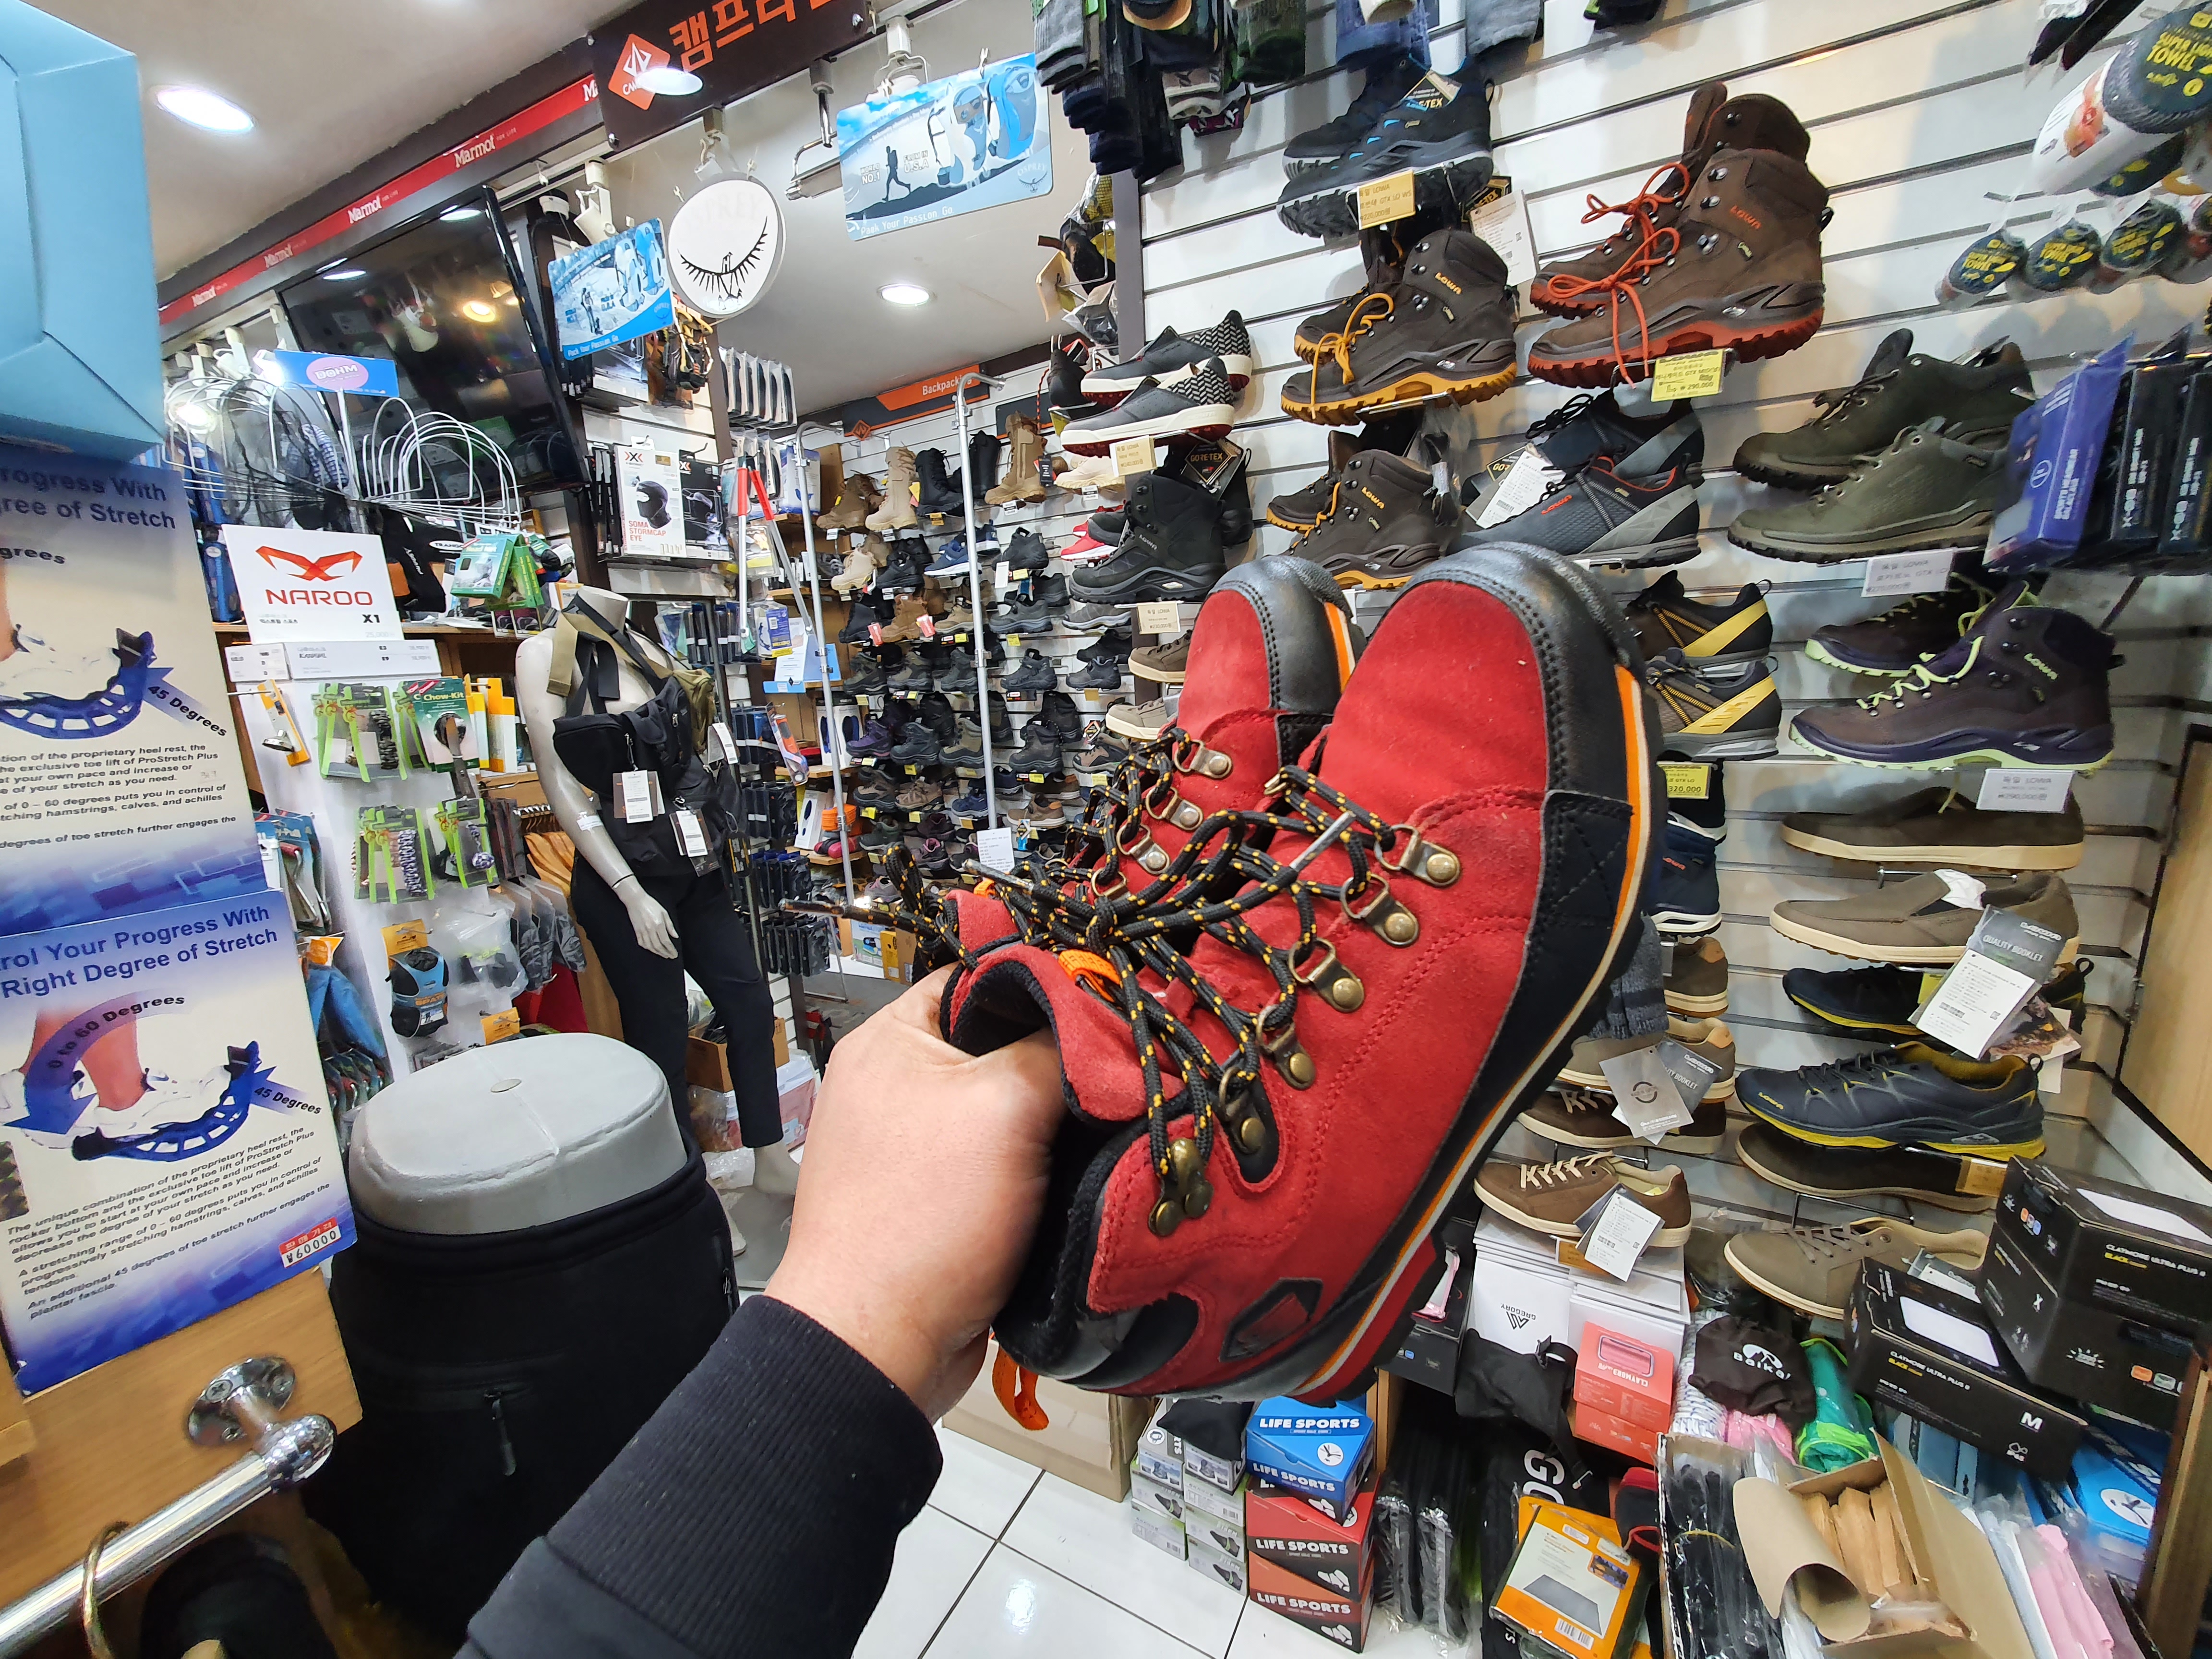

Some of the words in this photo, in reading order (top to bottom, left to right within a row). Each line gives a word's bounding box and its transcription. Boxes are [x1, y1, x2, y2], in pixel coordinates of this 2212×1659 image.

[2146, 45, 2197, 72] TOWEL
[454, 135, 496, 169] Marmot
[903, 152, 920, 163] FROM
[921, 150, 929, 159] IN
[860, 163, 880, 175] WORLD
[904, 160, 930, 173] U.S.A
[1016, 162, 1048, 177] OSPREY
[861, 173, 881, 185] NO.1
[1373, 184, 1390, 194] LOWA
[348, 195, 383, 224] Marmot
[1730, 205, 1761, 229] LOWA
[860, 221, 880, 236] Pack
[881, 217, 901, 231] Your
[264, 243, 293, 268] Marmot
[1435, 272, 1462, 294] LOWA
[110, 477, 167, 501] With
[1362, 487, 1385, 509] LOWA
[56, 500, 82, 519] of
[90, 503, 176, 529] Stretch
[628, 520, 649, 529] SOMA
[629, 528, 666, 537] STORMCAP
[1139, 534, 1157, 551] LOWA
[265, 589, 373, 605] NAROO
[362, 614, 380, 623] X1
[2024, 653, 2057, 680] LOWA
[423, 692, 465, 701] Chow-Kit
[148, 686, 169, 700] 45
[169, 697, 227, 737] Degrees
[20, 763, 81, 772] exclusive
[138, 754, 194, 764] ProStretch
[31, 753, 44, 761] of
[72, 748, 136, 759] proprietary
[139, 746, 161, 754] heel
[165, 745, 187, 753] rest,
[14, 775, 44, 784] your
[77, 771, 106, 780] pace
[109, 768, 131, 776] and
[134, 765, 179, 774] increase
[30, 784, 59, 793] your
[63, 780, 105, 790] stretch
[125, 778, 145, 786] you
[45, 799, 60, 807] 60
[63, 795, 111, 805] degrees
[114, 793, 139, 802] puts
[143, 791, 162, 800] you
[178, 784, 214, 795] control
[46, 805, 118, 817] hamstrings,
[121, 801, 159, 811] calves,
[163, 797, 182, 806] and
[185, 793, 223, 804] achilles
[0, 838, 51, 849] degrees
[94, 828, 134, 838] stretch
[137, 823, 173, 833] further
[176, 818, 219, 829] engages
[0, 948, 39, 971] rol
[46, 938, 108, 962] Your
[115, 917, 219, 950] Progress
[222, 906, 270, 928] With
[1983, 934, 2013, 951] QUALITY
[2011, 945, 2044, 962] BOOKLET
[1, 969, 78, 998] Right
[84, 952, 170, 983] Degree
[177, 944, 199, 962] of
[204, 928, 278, 957] Stretch
[74, 1020, 100, 1038] 60
[102, 996, 185, 1022] Degrees
[1674, 1072, 1699, 1090] BOOKLET
[254, 1086, 273, 1099] 45
[272, 1092, 323, 1115] Degrees
[149, 1176, 198, 1198] exclusive
[247, 1139, 294, 1162] ProStretch
[296, 1130, 314, 1142] Plus
[243, 1153, 282, 1173] increase
[35, 1208, 79, 1227] unique
[83, 1182, 155, 1212] combination
[191, 1150, 245, 1176] proprietary
[248, 1140, 267, 1153] heel
[290, 1127, 304, 1136] the
[287, 1166, 319, 1185] achilles
[184, 1197, 225, 1218] degrees
[281, 1162, 311, 1179] control
[184, 1186, 219, 1204] stretch
[247, 1206, 278, 1224] further
[279, 1189, 315, 1211] engages
[2150, 1256, 2177, 1269] ULTRA
[2176, 1264, 2199, 1275] PLUS
[1500, 1303, 1536, 1321] GREGORY
[1732, 1351, 1792, 1381] Baikal
[1890, 1350, 1926, 1371] CLAYMORE
[1926, 1367, 1947, 1381] ULTRA
[1947, 1376, 1965, 1389] PLUS
[1259, 1418, 1292, 1429] LIFE
[1295, 1419, 1360, 1429] SPORTS
[2020, 1411, 2044, 1431] M
[1253, 1463, 1278, 1478] LIFE
[1281, 1471, 1336, 1492] SPORTS
[1255, 1539, 1286, 1551] LIFE
[1287, 1541, 1349, 1555] SPORTS
[1257, 1592, 1286, 1606] LIFE
[1289, 1599, 1351, 1615] SPORTS
